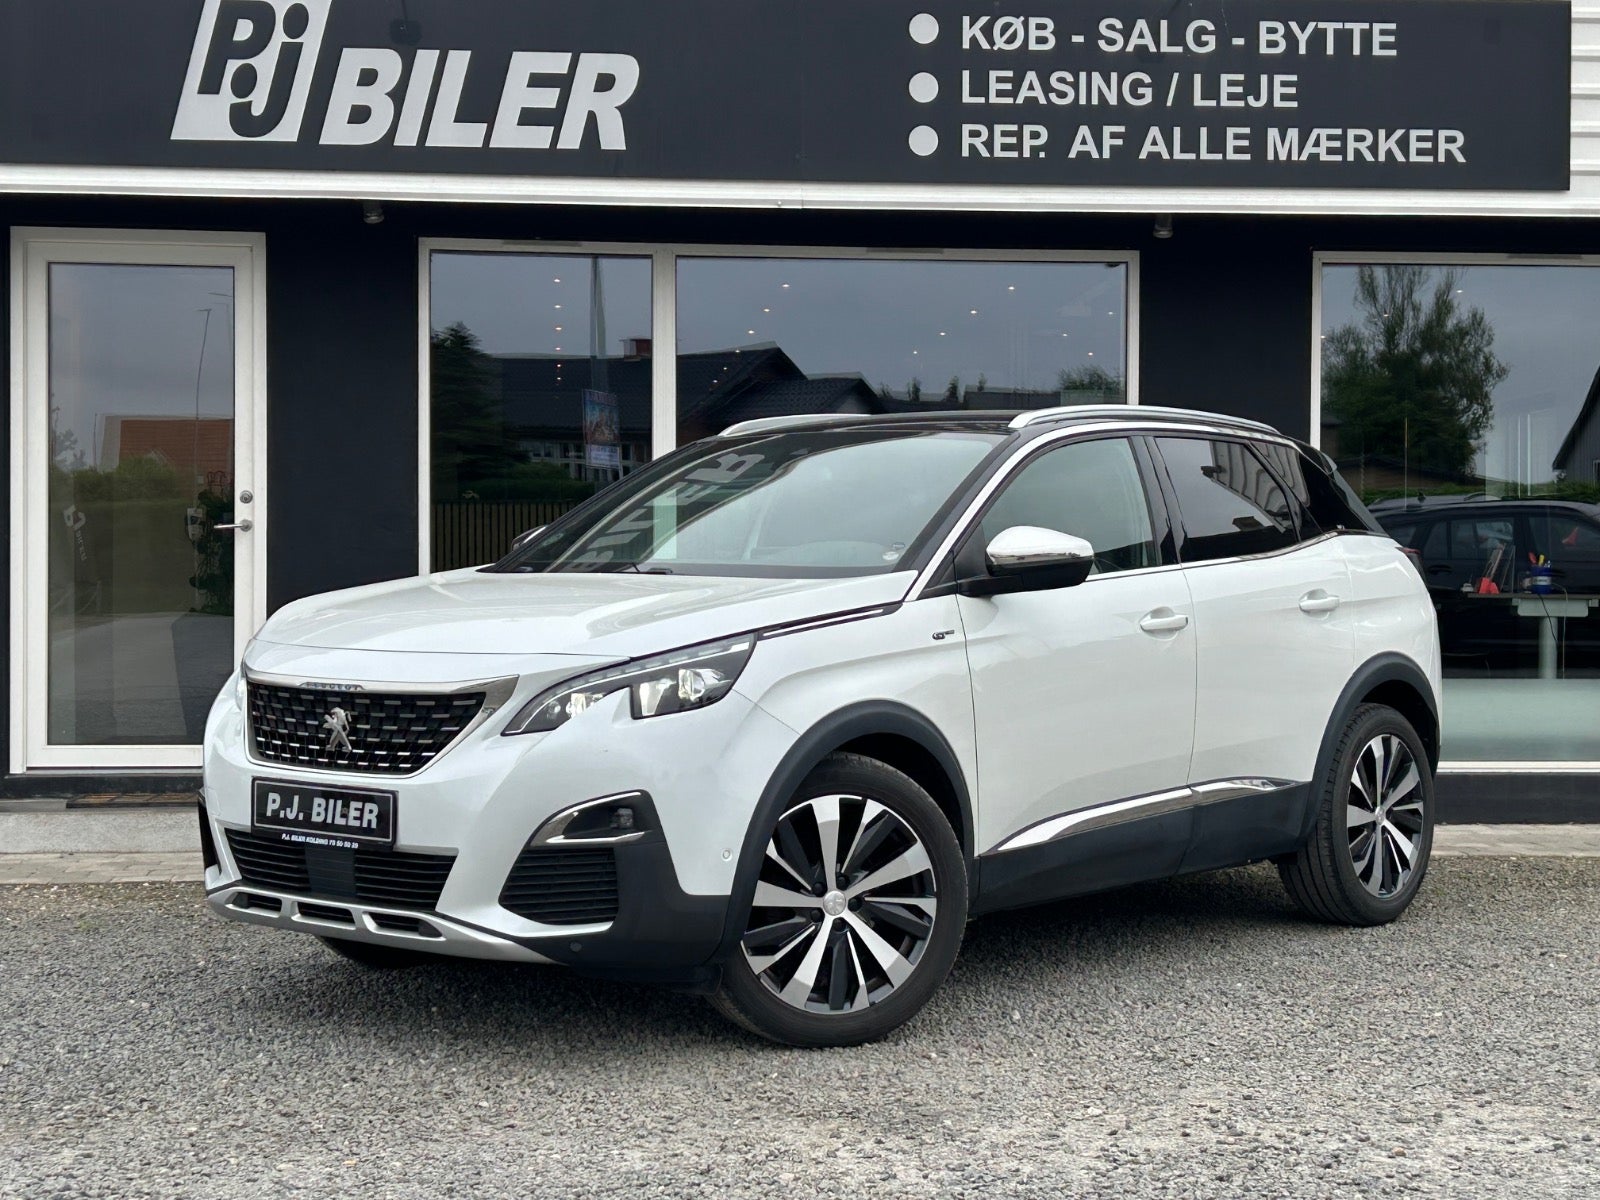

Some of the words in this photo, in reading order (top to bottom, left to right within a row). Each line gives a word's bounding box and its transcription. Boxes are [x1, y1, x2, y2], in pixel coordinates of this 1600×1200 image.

[963, 16, 1055, 50] KØB
[1098, 18, 1215, 53] SALG
[1260, 21, 1397, 56] BYTTE
[319, 48, 639, 150] BILER
[962, 70, 1152, 106] LEASING
[1194, 74, 1298, 107] LEJE
[962, 124, 1049, 158] REP.
[1068, 126, 1125, 158] AF
[1139, 126, 1250, 160] ALLE
[1268, 128, 1466, 162] MÆRKER
[266, 793, 304, 820] P.J.
[311, 798, 379, 828] BILER
